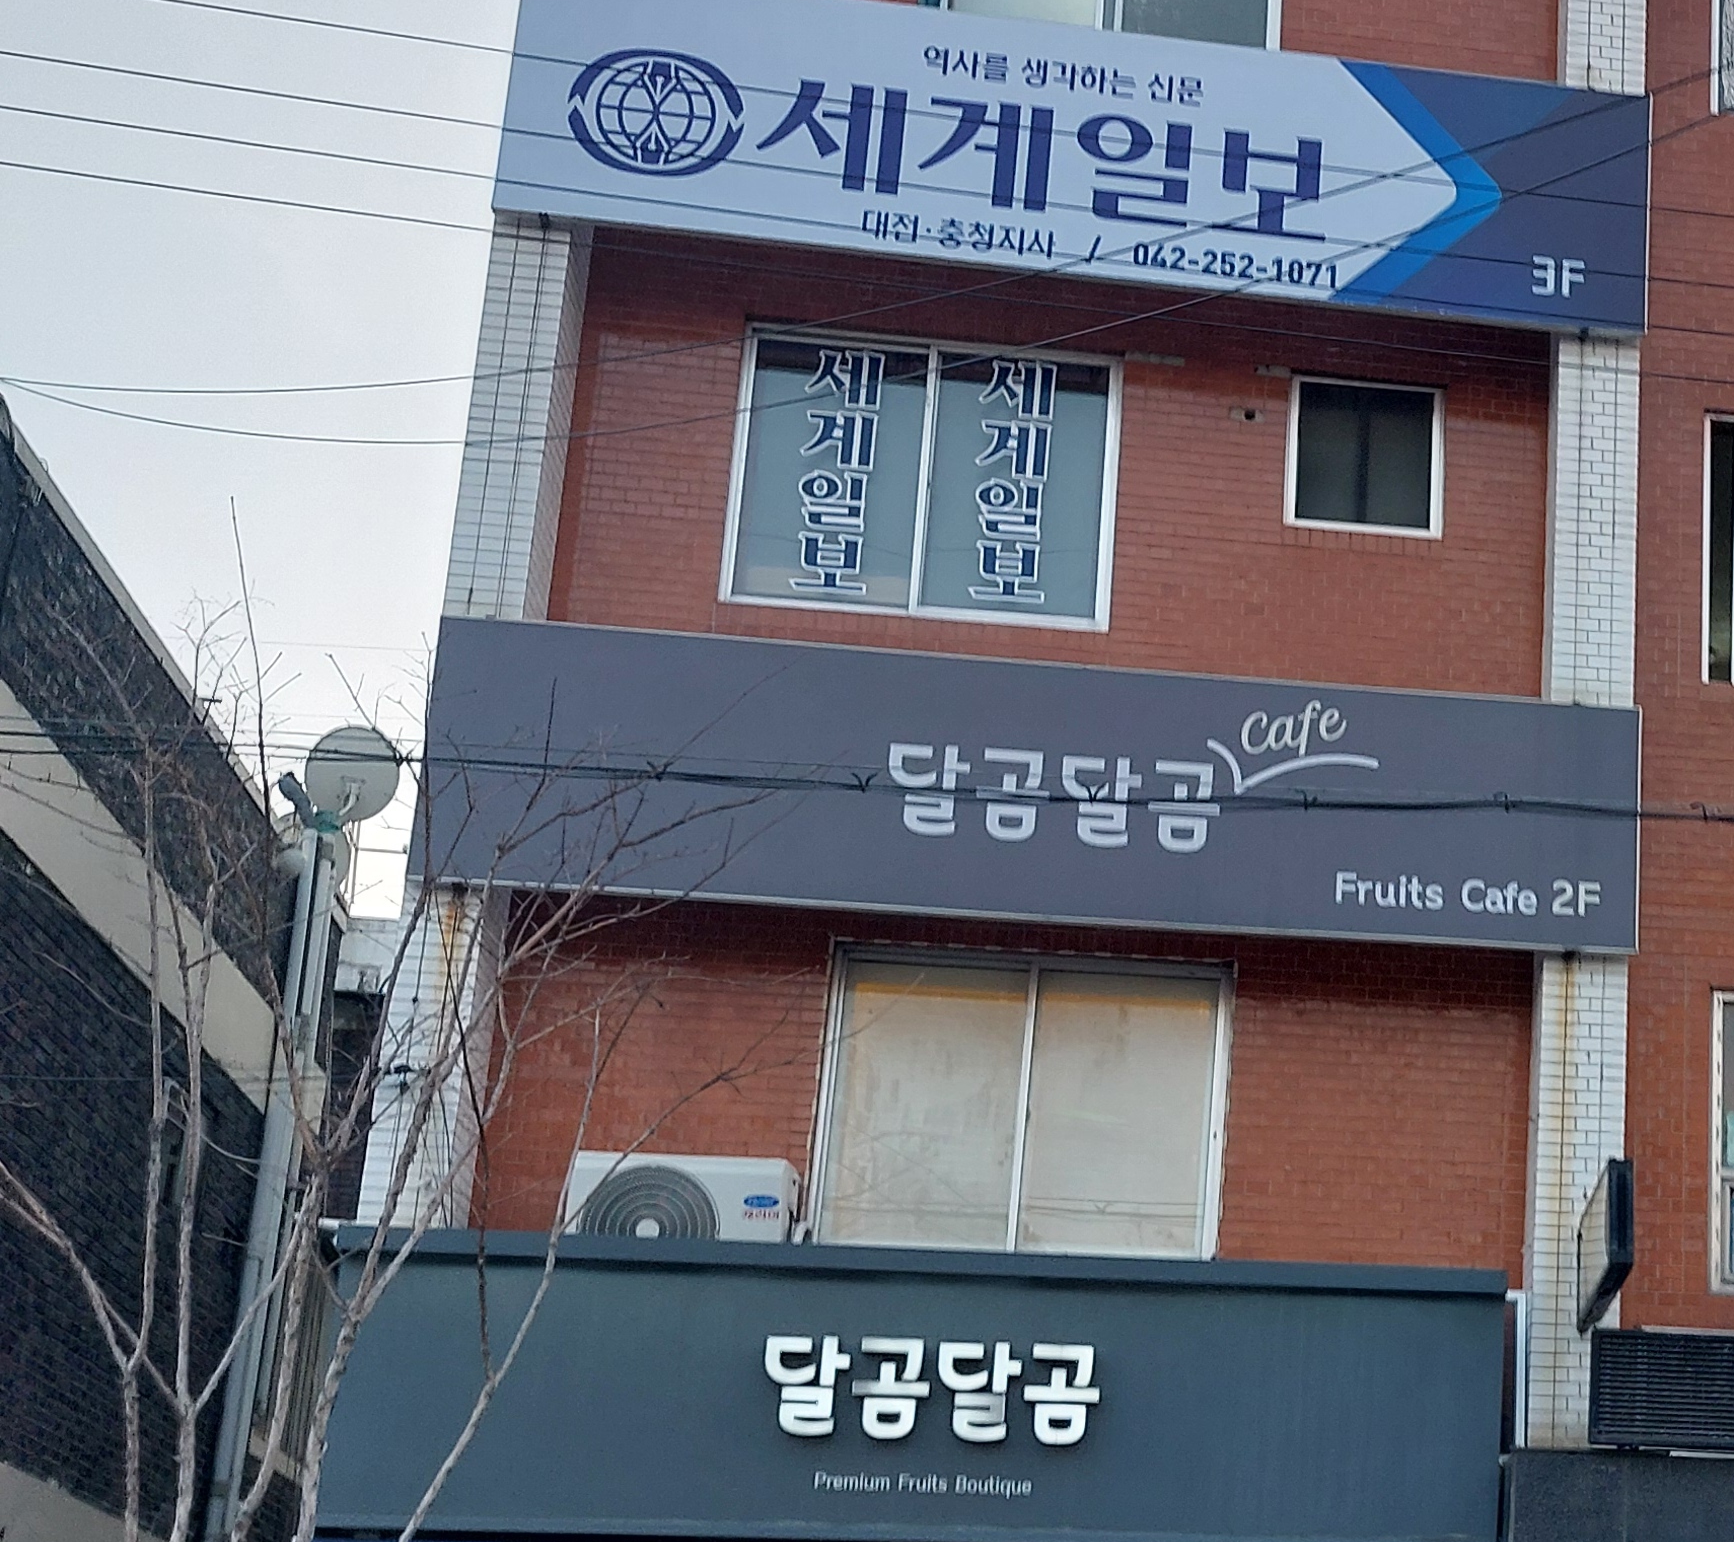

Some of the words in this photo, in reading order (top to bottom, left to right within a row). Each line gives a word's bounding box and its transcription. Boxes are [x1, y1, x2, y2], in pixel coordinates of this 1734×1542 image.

[922, 45, 1010, 84] 역사를
[1022, 57, 1137, 100] 생각하는
[1147, 73, 1204, 107] 신문
[755, 78, 1327, 243] 세계일보
[1132, 243, 1339, 289] 042-252-1071
[1531, 254, 1586, 299] 3F
[788, 348, 886, 597] 세계일보
[967, 359, 1058, 604] 세계일보
[1333, 869, 1446, 912] Fruits
[1460, 877, 1538, 916] Cafe
[1550, 877, 1602, 918] 2F
[813, 1470, 890, 1491] Premium
[899, 1472, 948, 1494] Fruits
[954, 1474, 1033, 1499] Boutique
